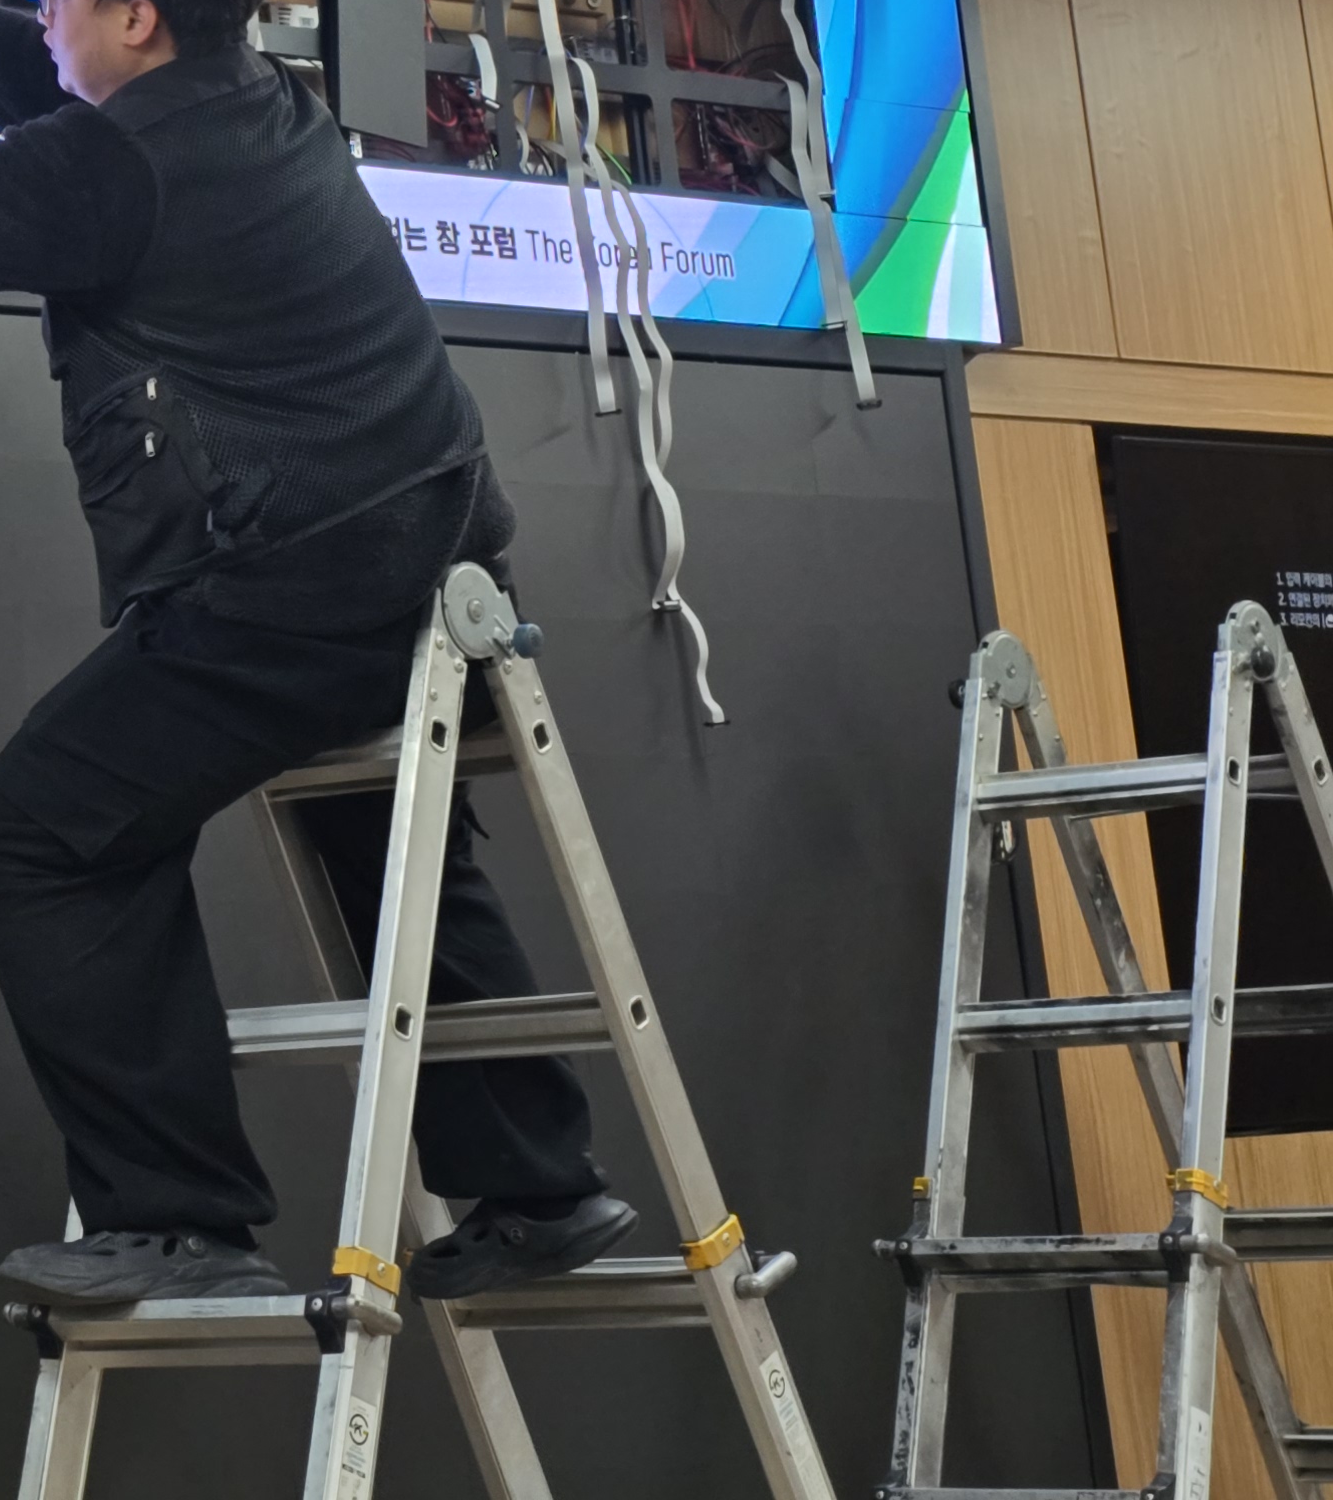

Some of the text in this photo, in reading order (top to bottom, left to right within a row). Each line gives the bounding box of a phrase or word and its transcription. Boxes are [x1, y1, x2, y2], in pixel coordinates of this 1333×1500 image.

[436, 219, 460, 256] 창
[469, 223, 518, 261] 포럼
[524, 228, 574, 265] The
[660, 241, 735, 278] Forum
